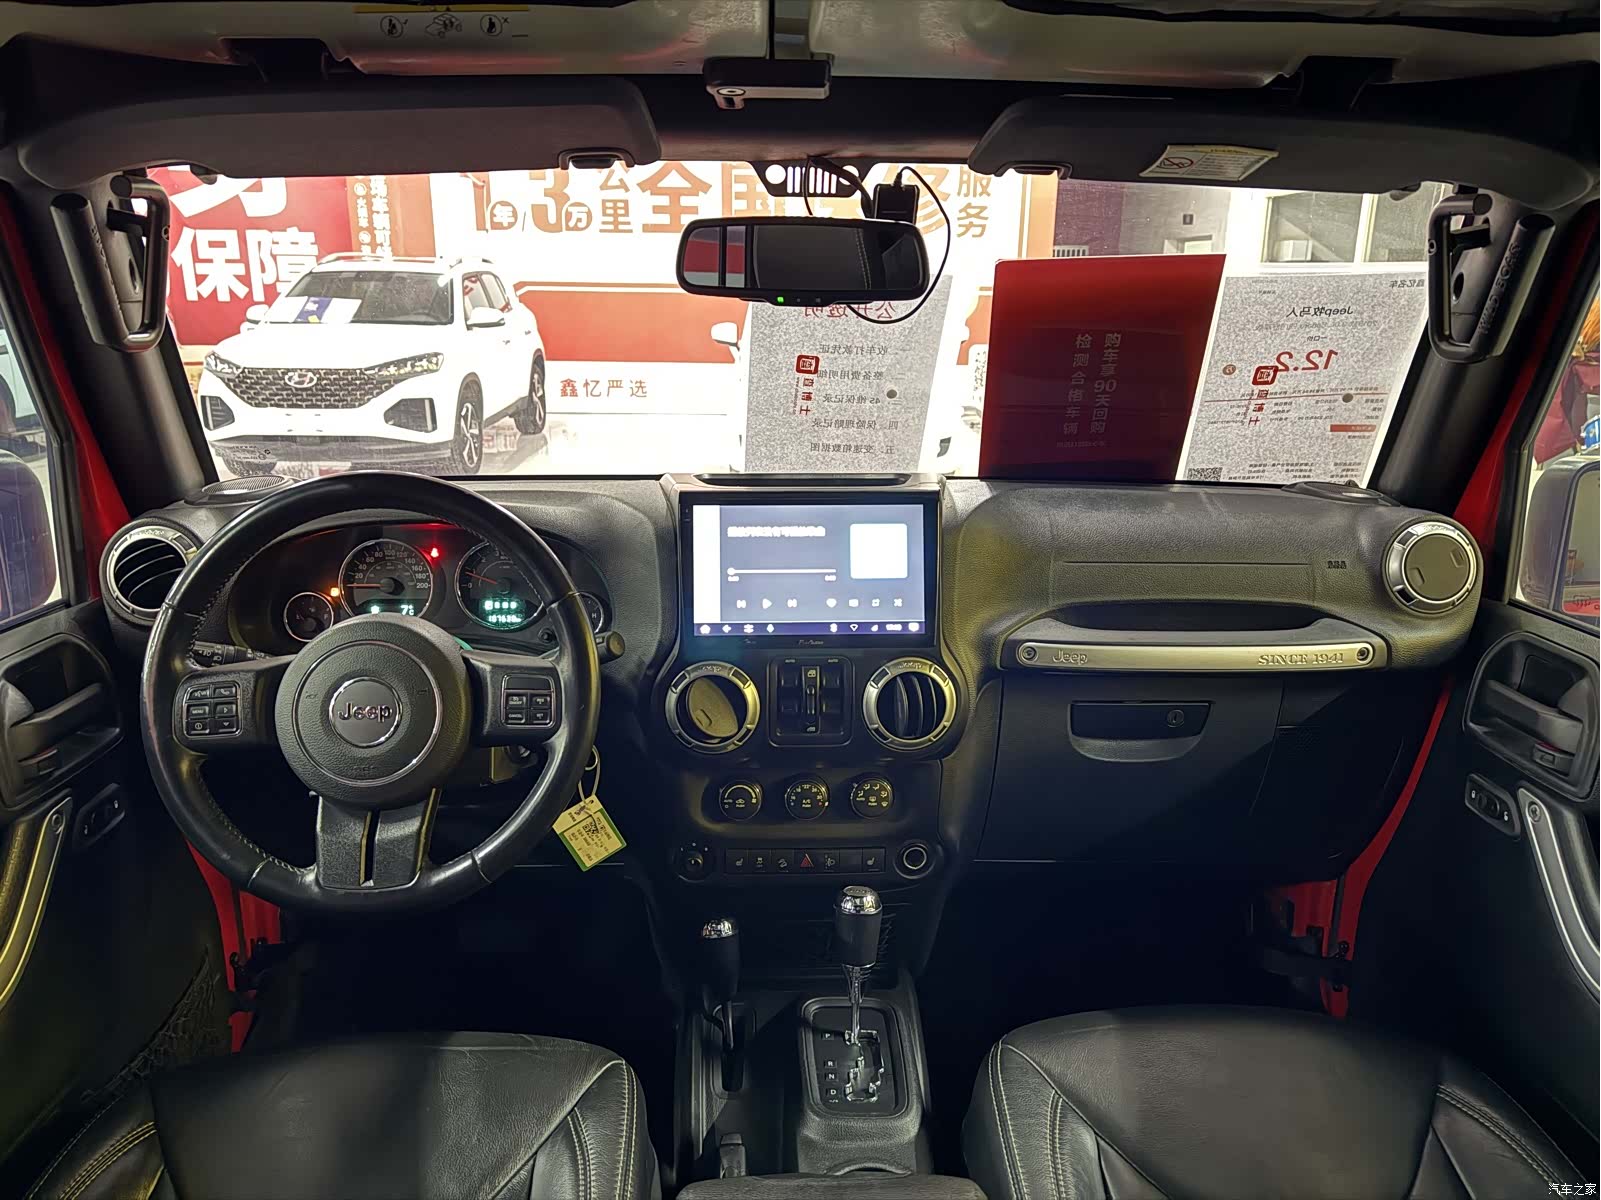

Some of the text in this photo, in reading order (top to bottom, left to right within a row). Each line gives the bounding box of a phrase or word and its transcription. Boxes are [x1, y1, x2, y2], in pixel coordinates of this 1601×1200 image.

[171, 226, 319, 302] 保障
[559, 378, 648, 398] 鑫忆严选
[1051, 650, 1089, 666] Jeep
[1258, 652, 1345, 666] SINCE 1941
[337, 702, 393, 723] Jeep
